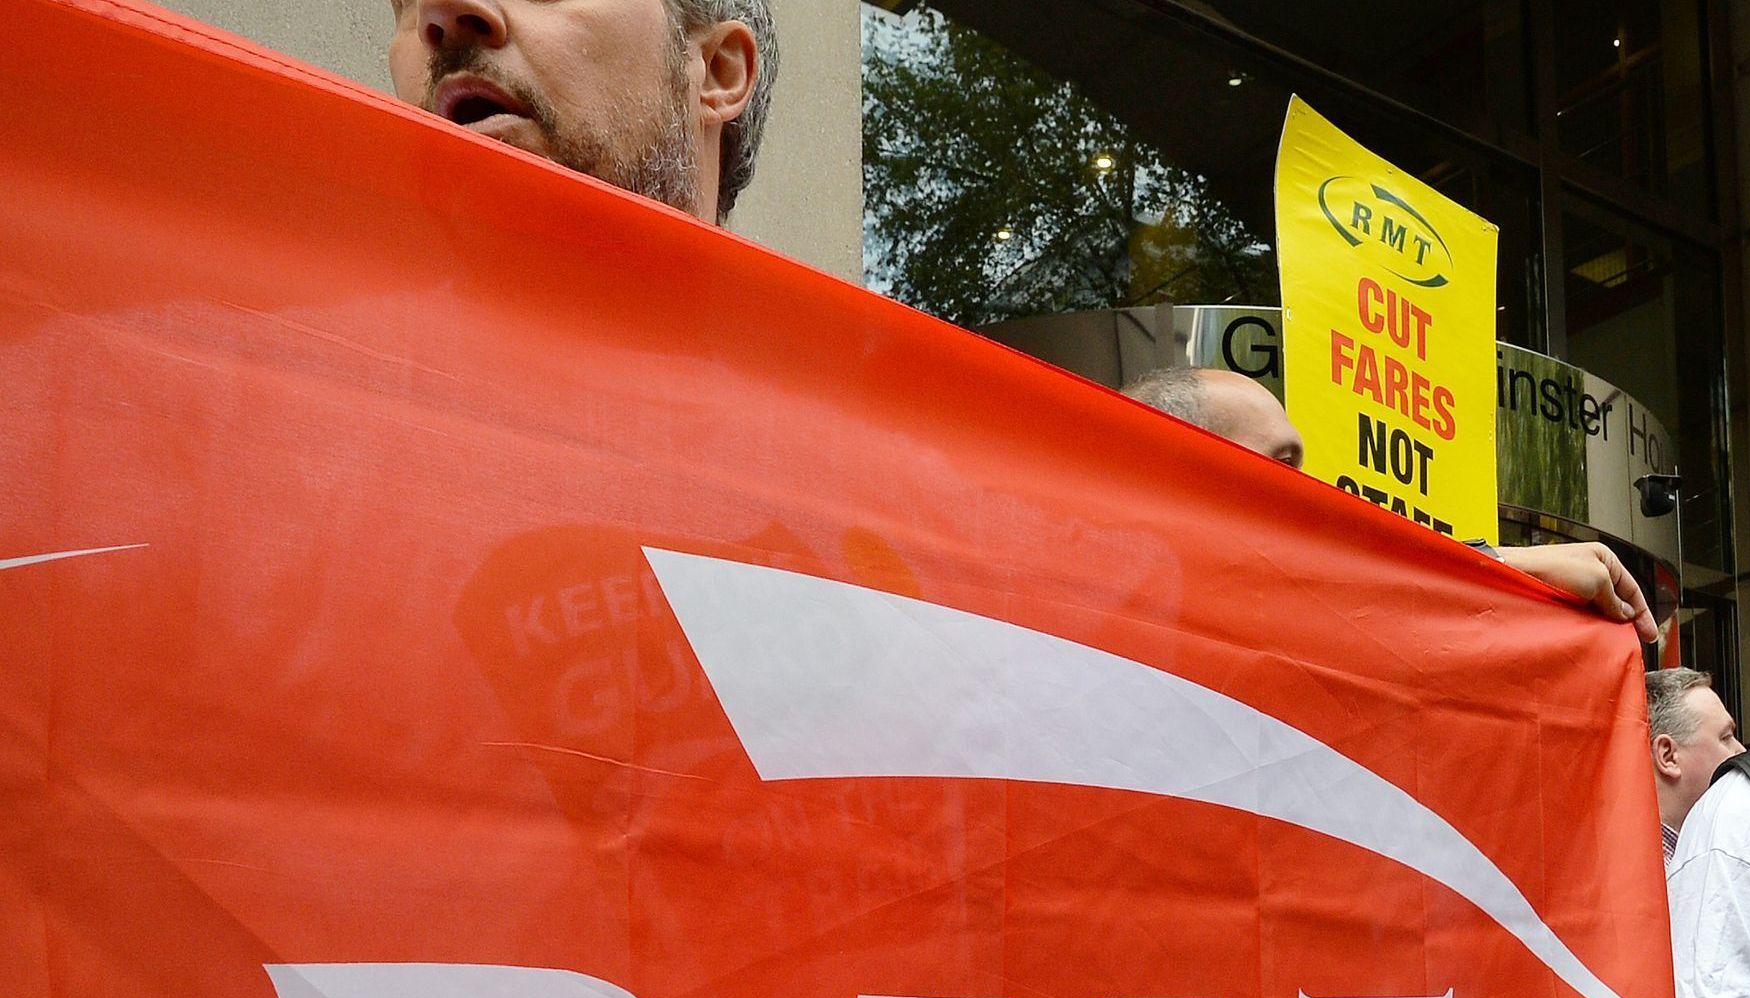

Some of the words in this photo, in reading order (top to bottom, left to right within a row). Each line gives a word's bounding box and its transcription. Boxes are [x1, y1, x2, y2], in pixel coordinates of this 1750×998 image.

[1350, 201, 1432, 266] RMT
[1358, 277, 1432, 361] CUT
[1331, 329, 1456, 441] FARES
[1497, 351, 1613, 442] inster
[1358, 412, 1434, 496] NOT
